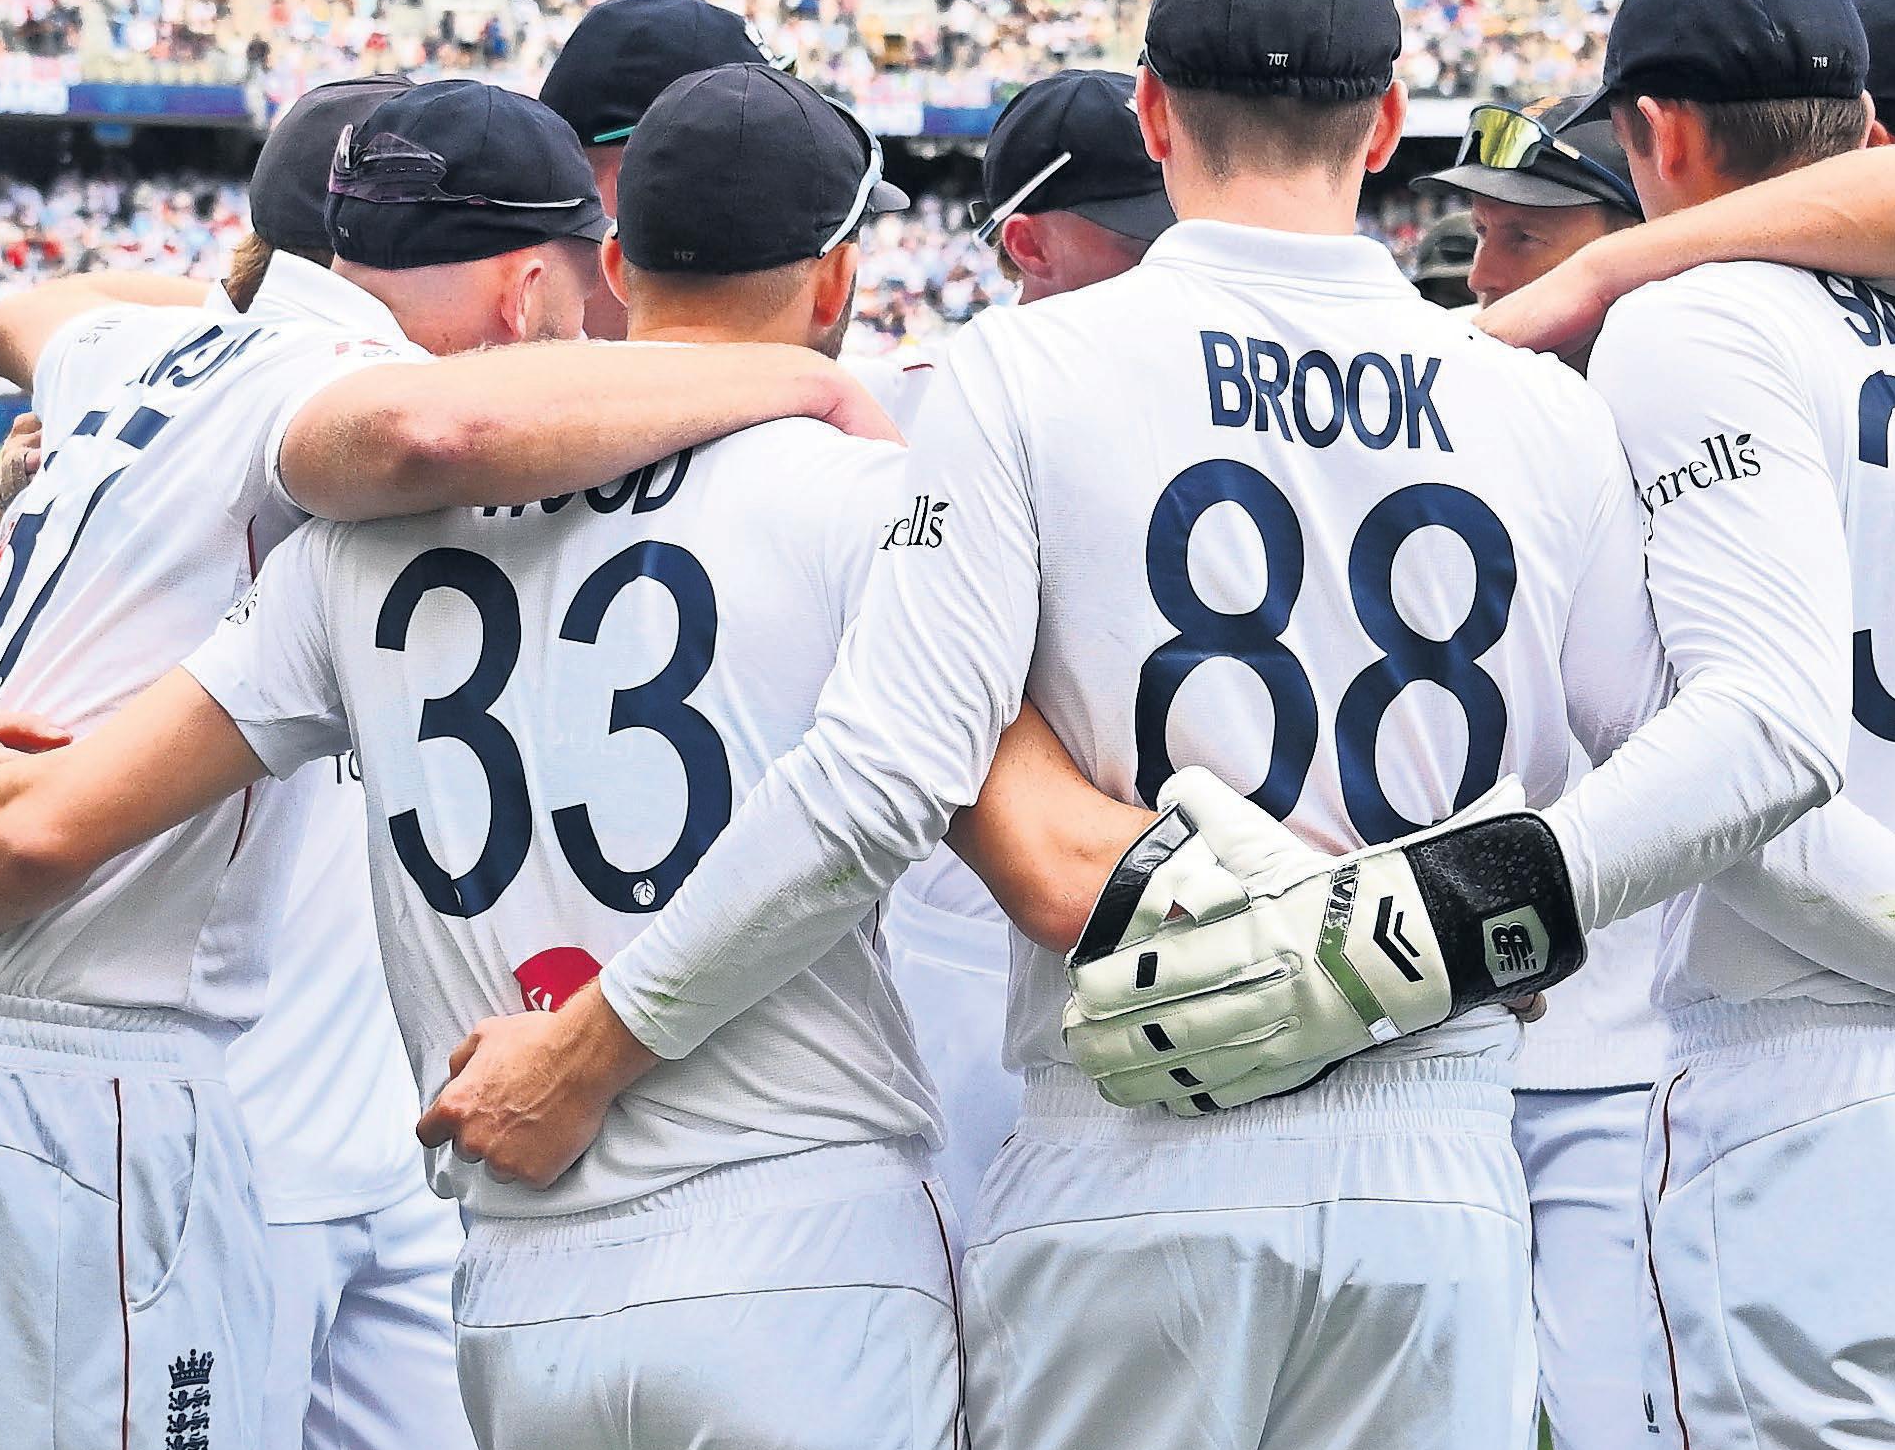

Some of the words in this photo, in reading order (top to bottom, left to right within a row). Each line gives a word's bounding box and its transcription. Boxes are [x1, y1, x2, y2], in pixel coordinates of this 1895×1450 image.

[1267, 53, 1289, 67] 707
[1199, 330, 1454, 453] BROOK
[374, 539, 734, 918] 33
[1134, 457, 1518, 847] 88
